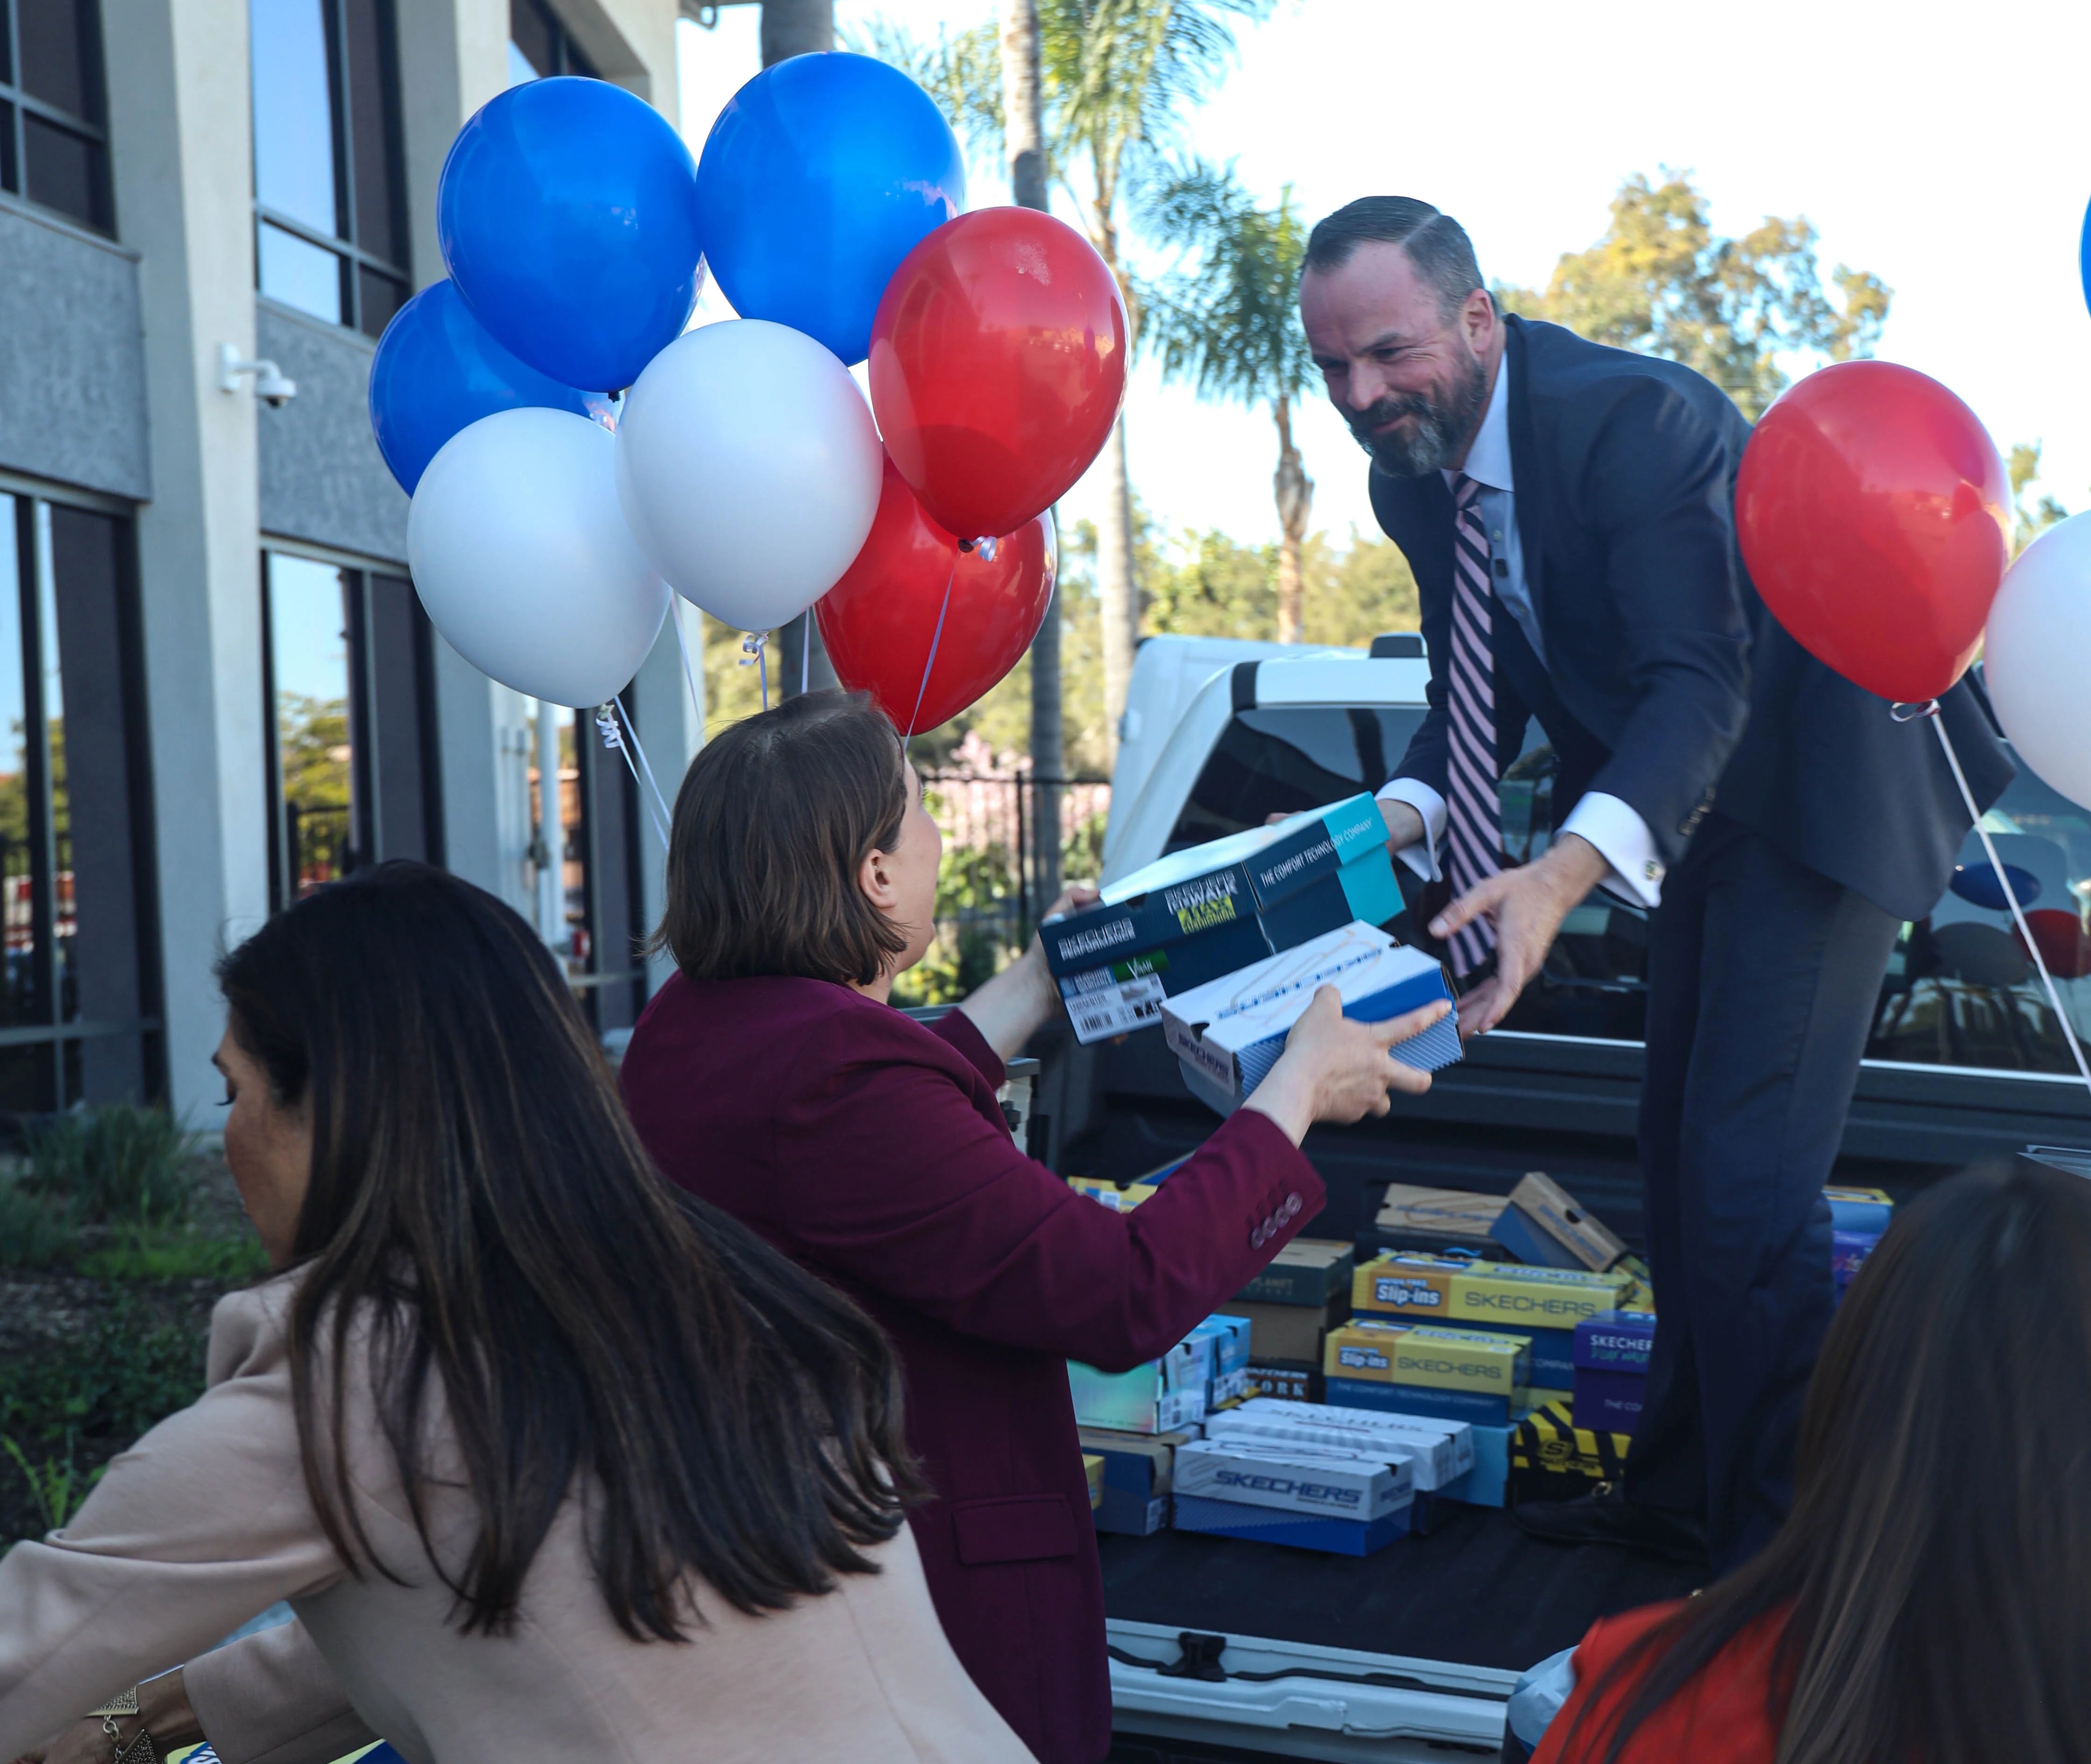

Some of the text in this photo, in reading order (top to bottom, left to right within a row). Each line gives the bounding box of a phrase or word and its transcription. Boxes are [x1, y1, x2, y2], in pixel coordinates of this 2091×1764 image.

[1260, 818, 1372, 888] THE COMFORT TECHNOLOGY COMPANY
[1378, 1284, 1440, 1306] Slip-ins
[1465, 1291, 1596, 1317] SKECHERS
[1397, 1356, 1502, 1379] SKECHERS
[1214, 1470, 1365, 1505] SKECHERS
